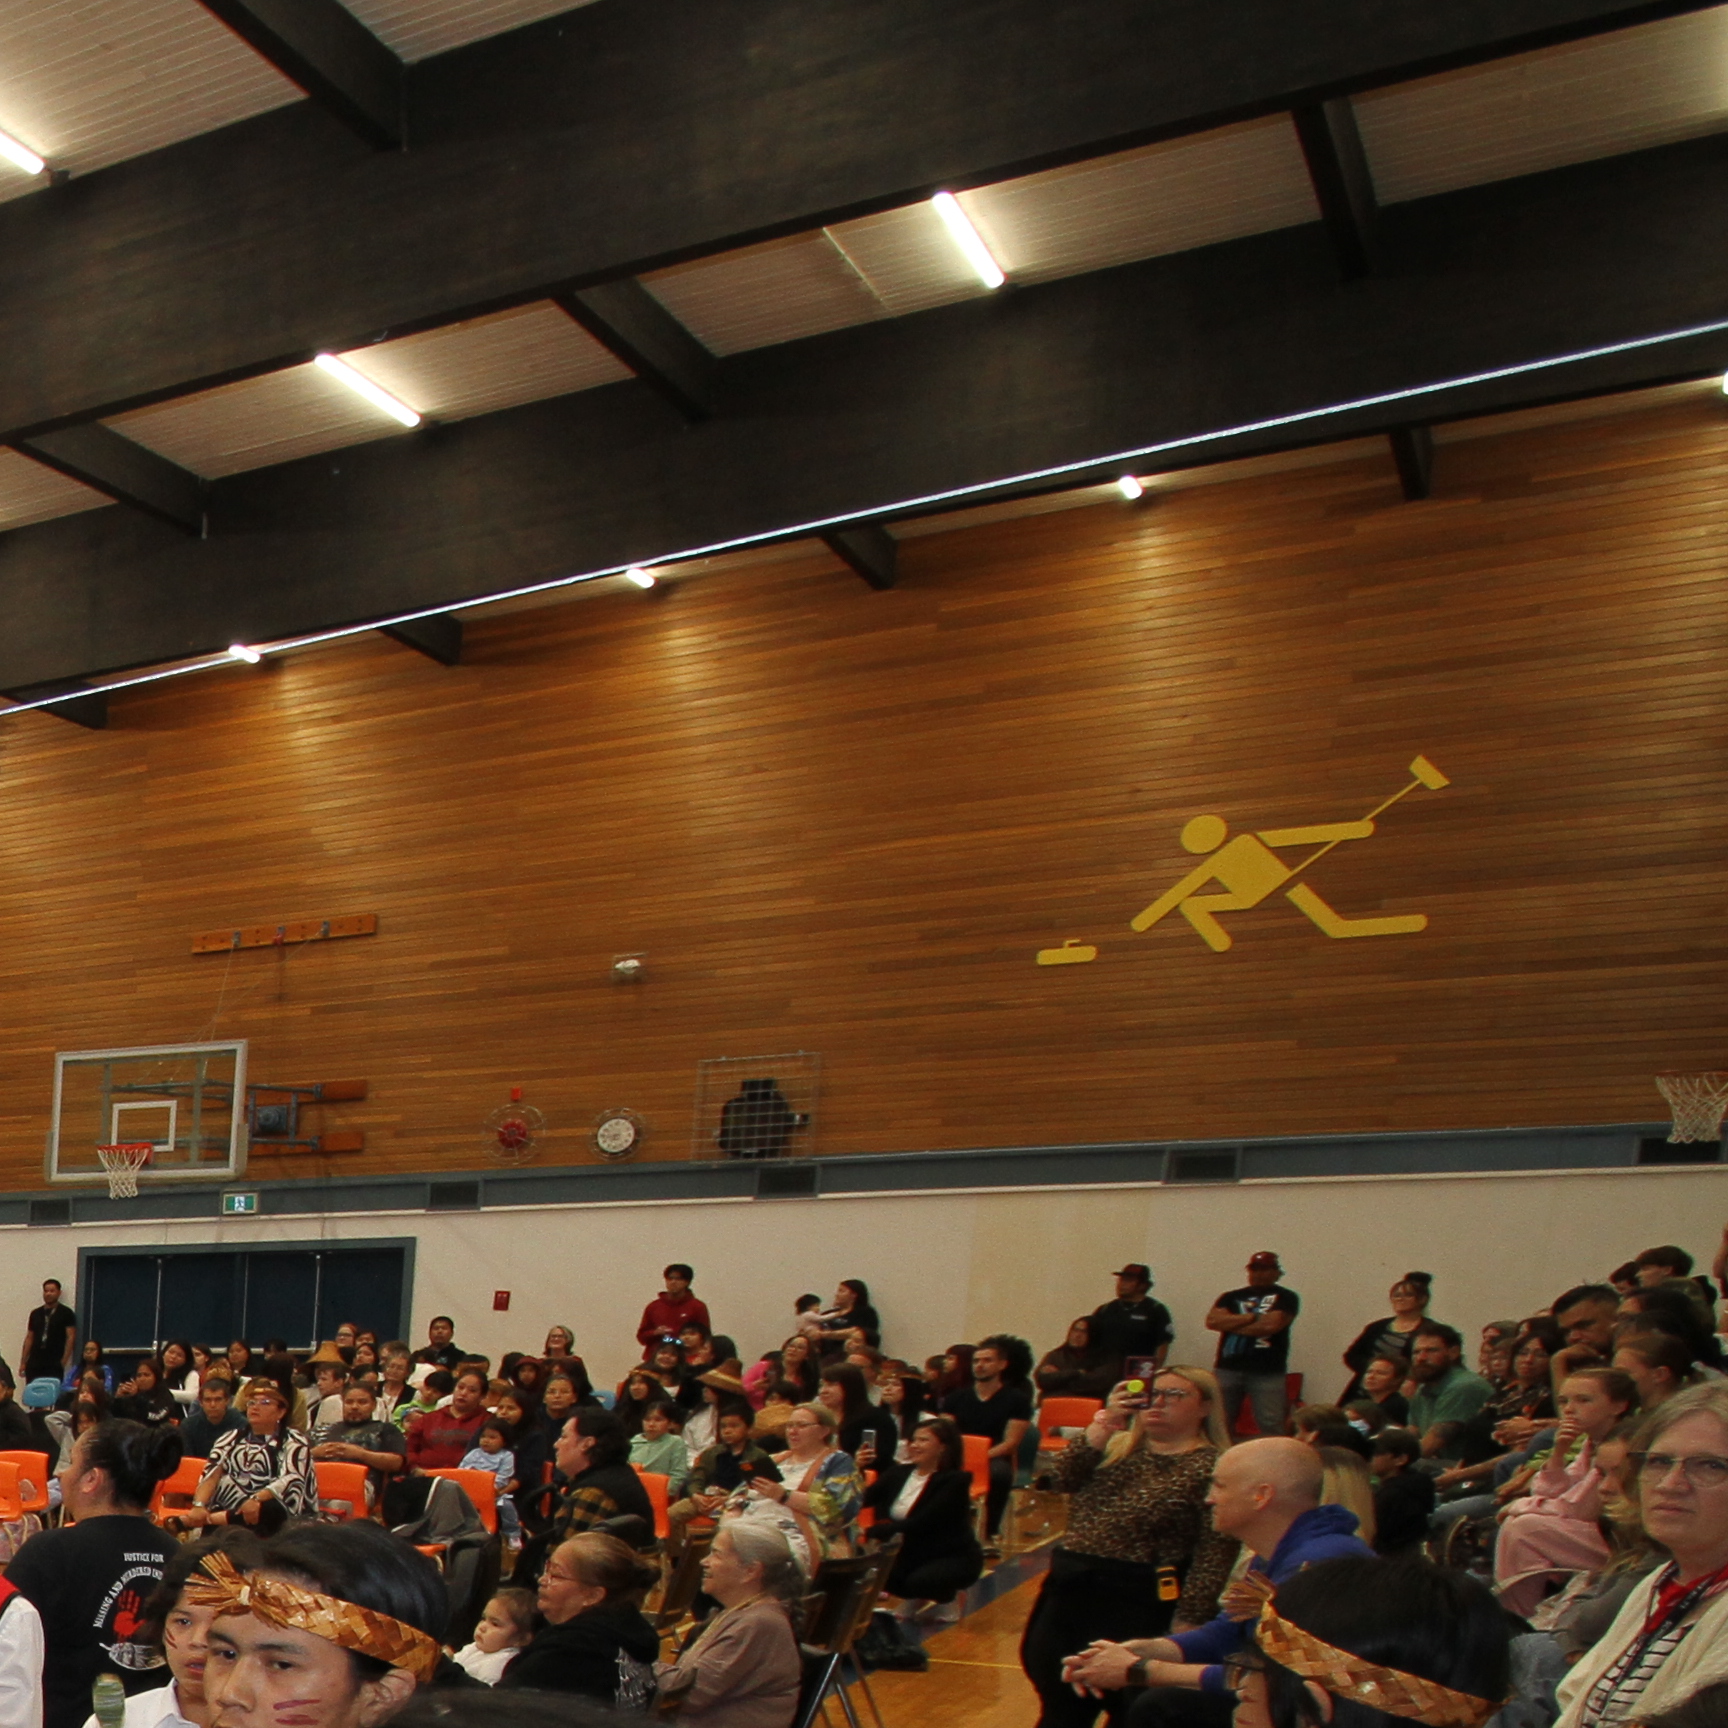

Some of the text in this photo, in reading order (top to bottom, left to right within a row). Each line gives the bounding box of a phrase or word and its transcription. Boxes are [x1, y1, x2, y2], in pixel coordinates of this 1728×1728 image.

[124, 1552, 165, 1563] JUSTICE FOR
[92, 1596, 114, 1628] MISSING
[108, 1581, 124, 1599] AND
[120, 1566, 152, 1585] MURDERED
